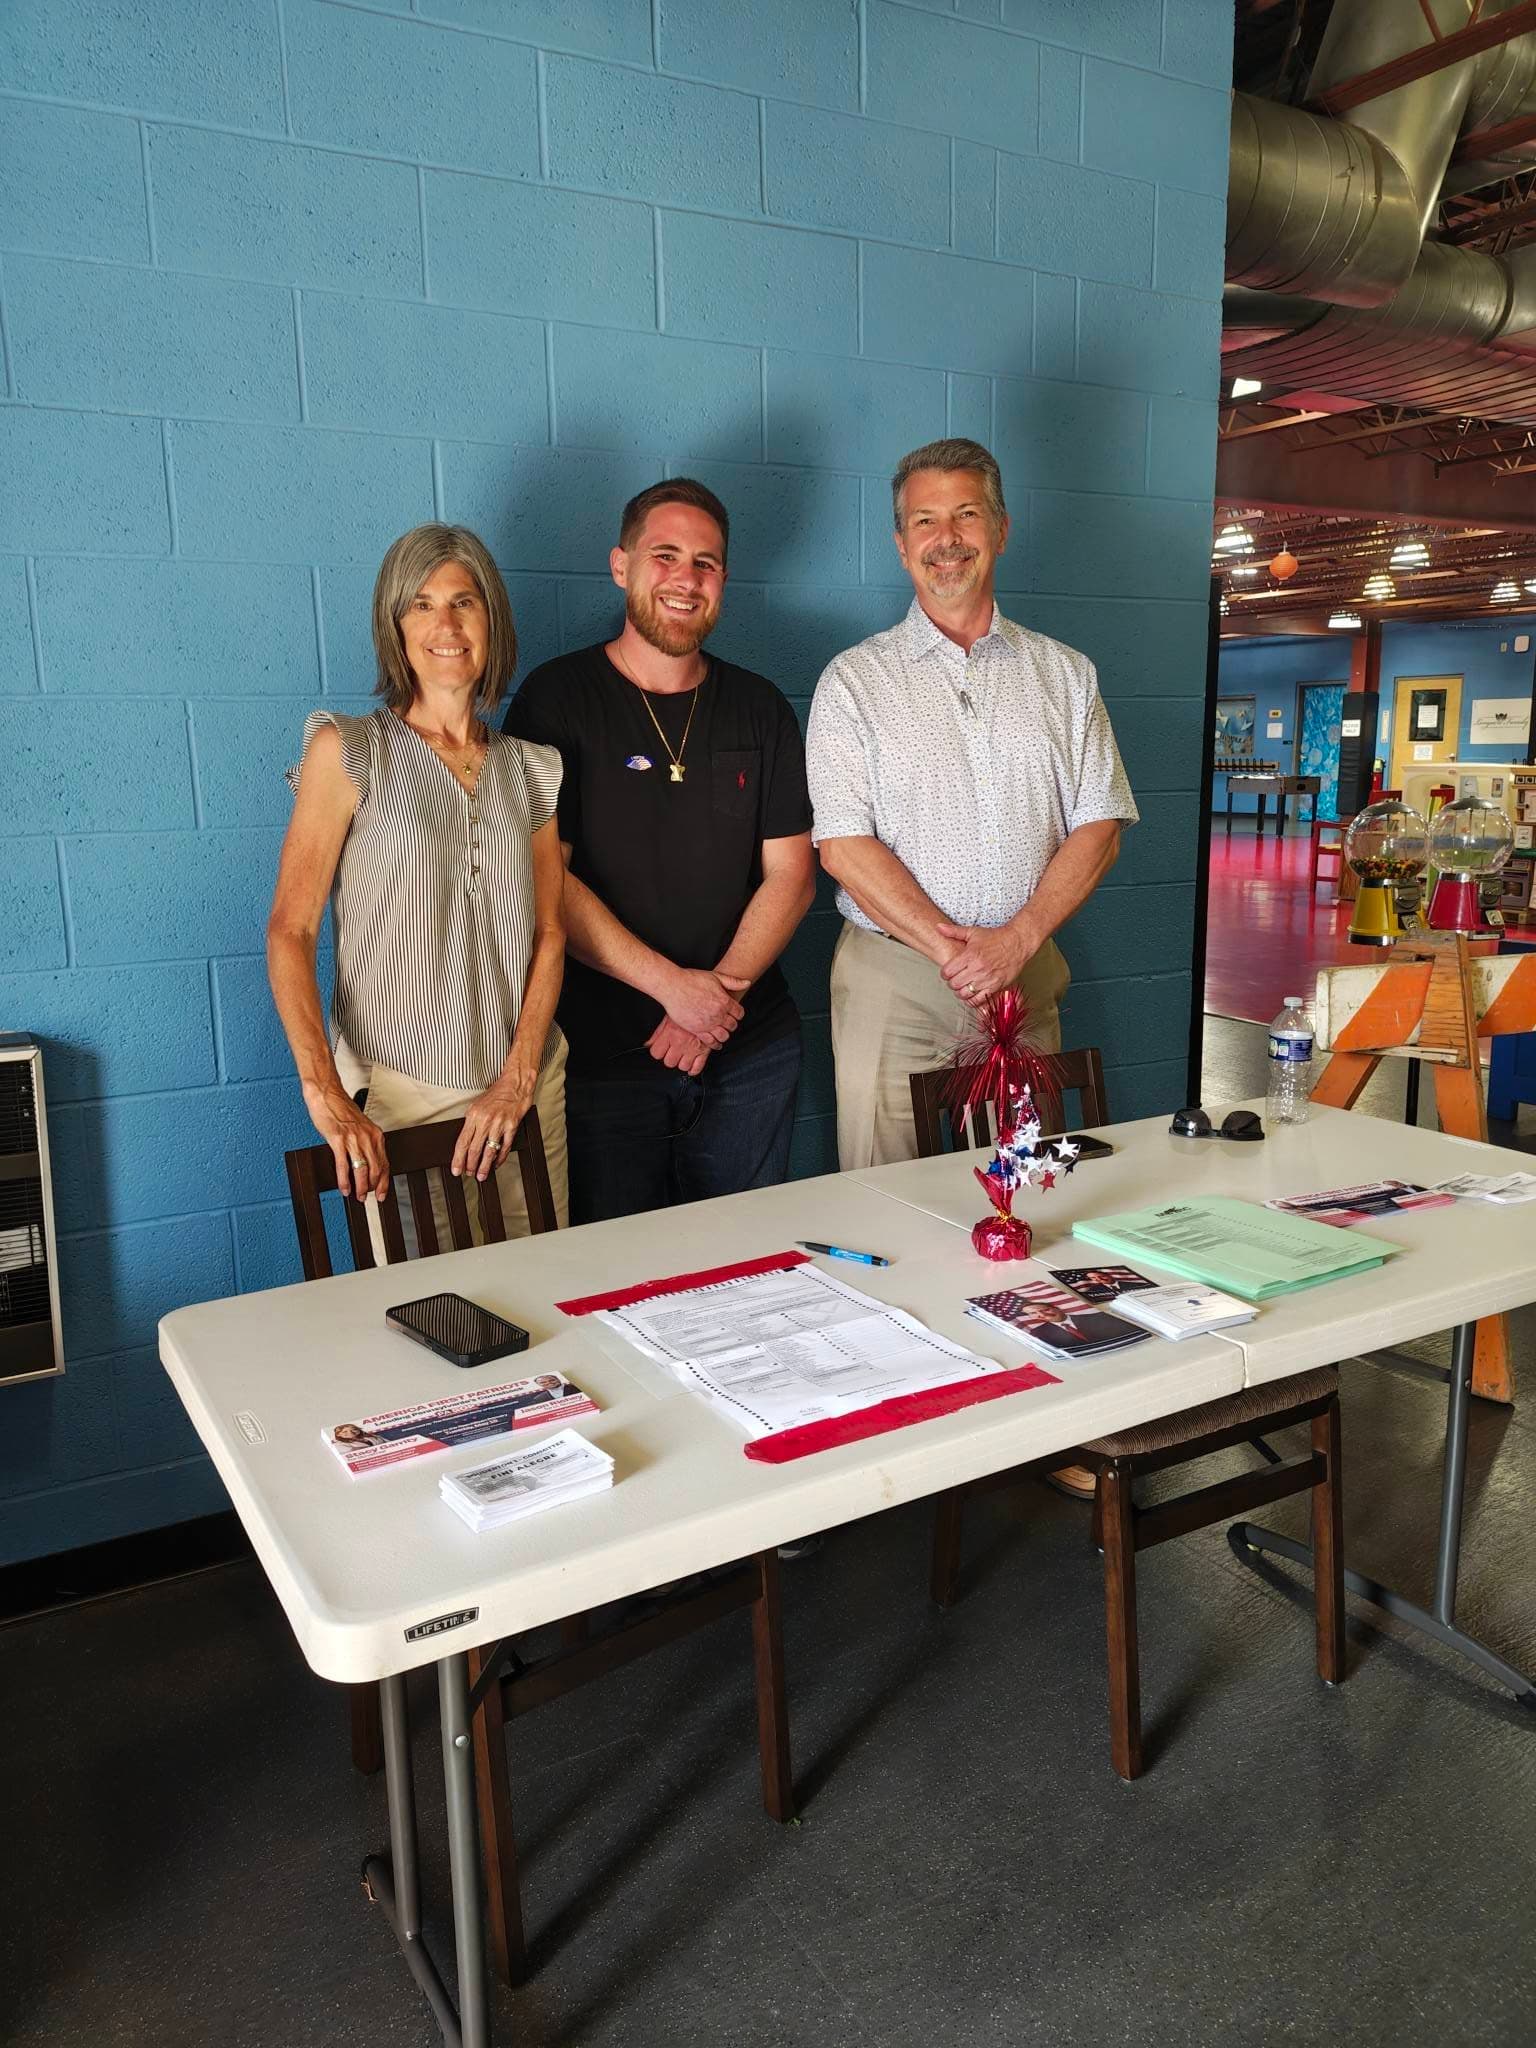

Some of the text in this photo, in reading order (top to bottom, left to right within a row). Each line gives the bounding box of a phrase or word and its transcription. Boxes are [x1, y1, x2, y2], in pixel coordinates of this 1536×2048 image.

[362, 1405, 426, 1425] AMERICA
[427, 1394, 465, 1408] FIRST
[466, 1380, 529, 1398] PATRIOTS
[374, 1413, 411, 1427] Leading
[411, 1397, 476, 1417] Pennsylvania's
[477, 1387, 524, 1400] Comeback
[344, 1446, 378, 1460] Stacy
[380, 1437, 418, 1451] Garrity
[522, 1440, 566, 1460] COMMITTEE
[517, 1452, 558, 1471] ALEGRE
